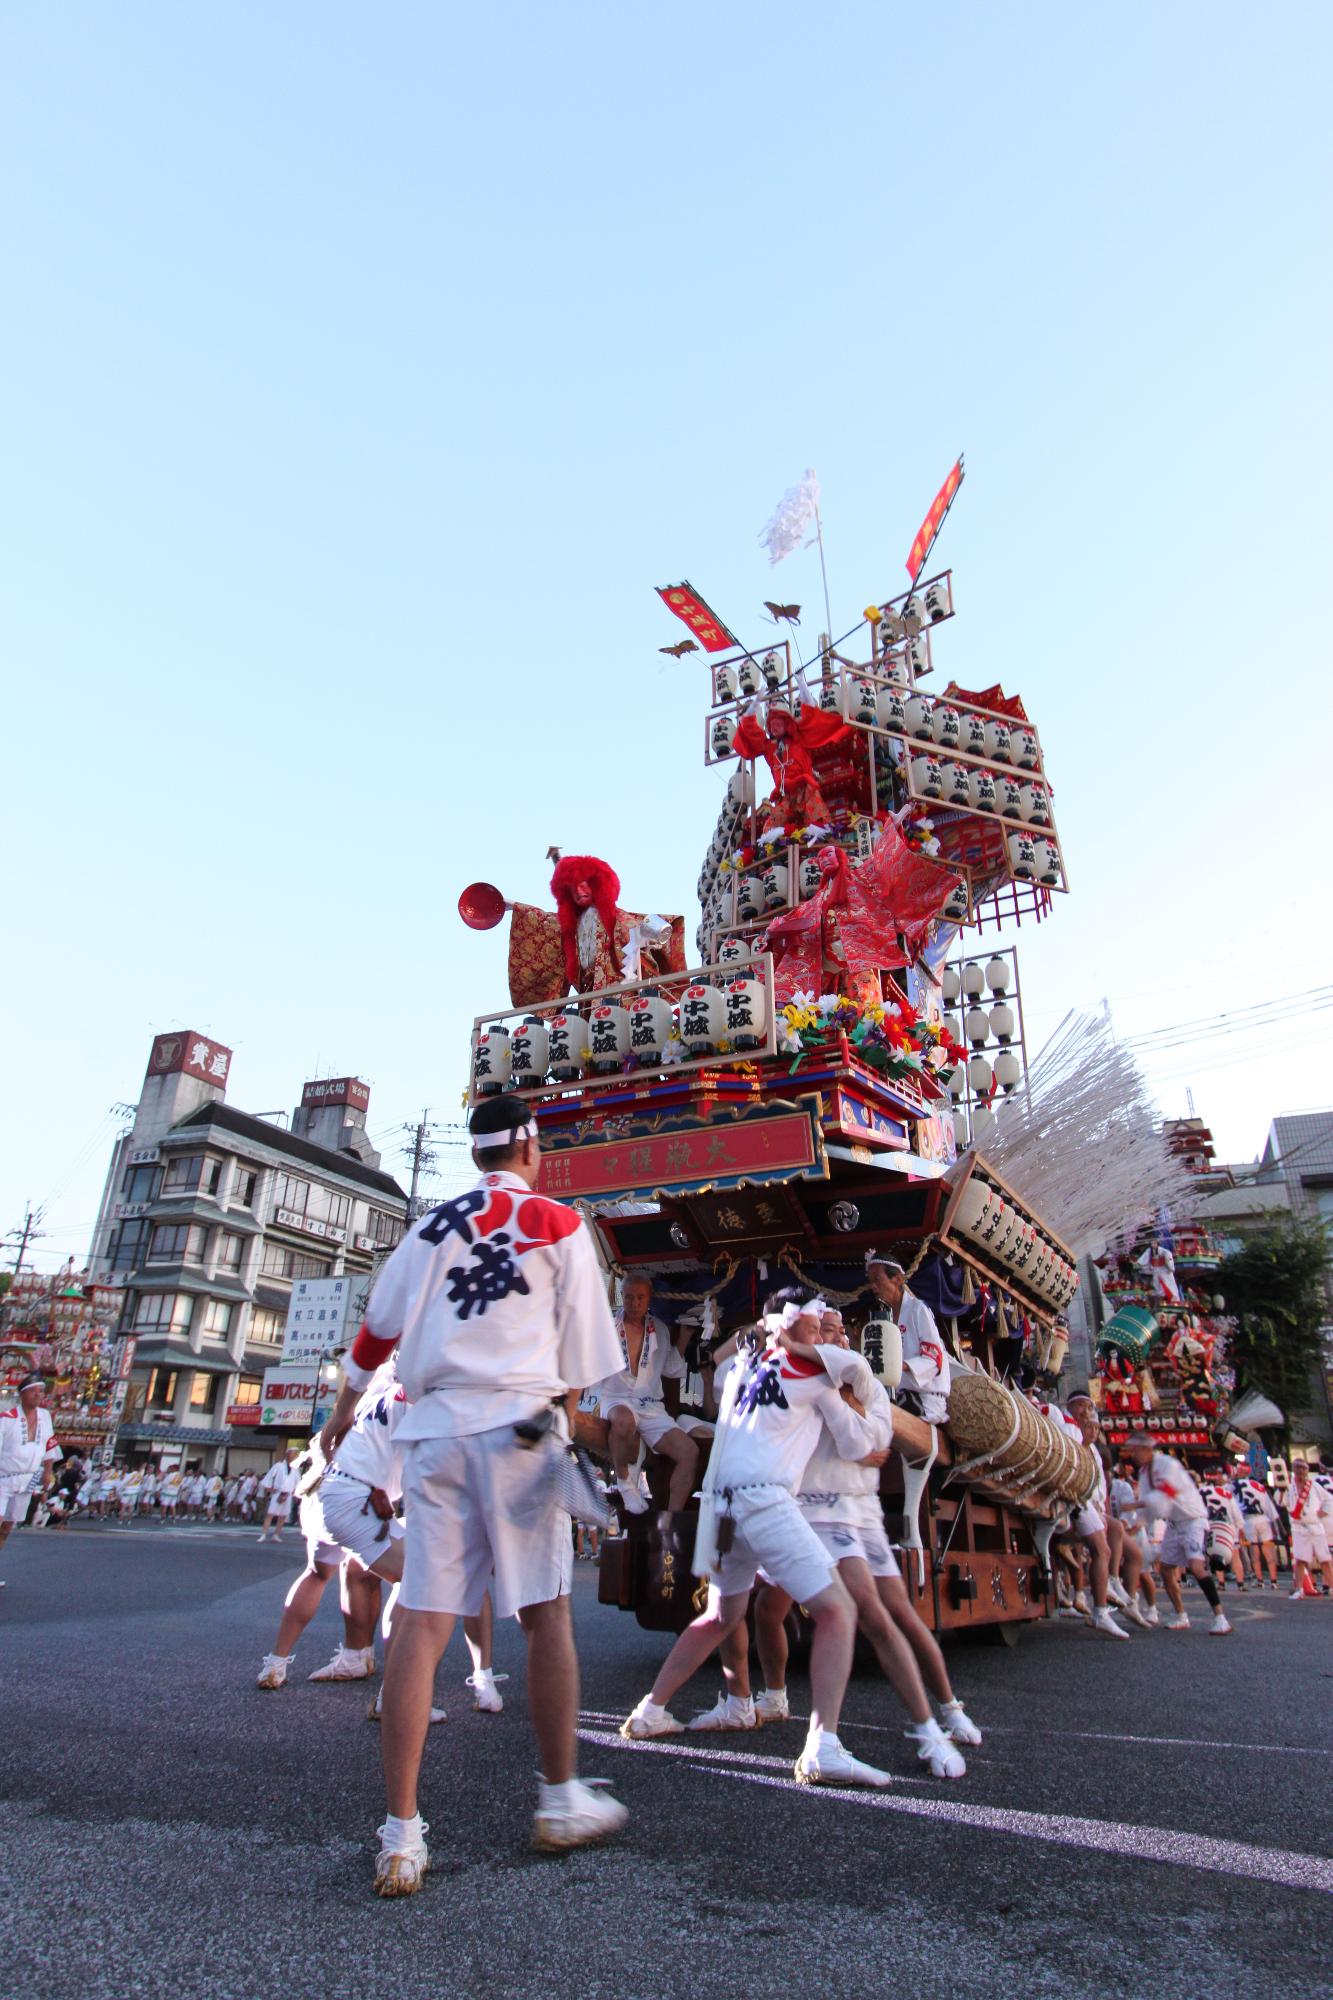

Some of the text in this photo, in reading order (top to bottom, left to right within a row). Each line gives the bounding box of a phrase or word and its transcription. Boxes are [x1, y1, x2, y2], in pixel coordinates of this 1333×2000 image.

[631, 1012, 657, 1047] 中城
[684, 1000, 711, 1037] 中城
[727, 994, 754, 1030] 中城
[511, 1038, 533, 1071] 中城
[549, 1030, 570, 1062] 中城
[592, 1020, 618, 1055] 中城
[474, 1046, 493, 1078] 中城
